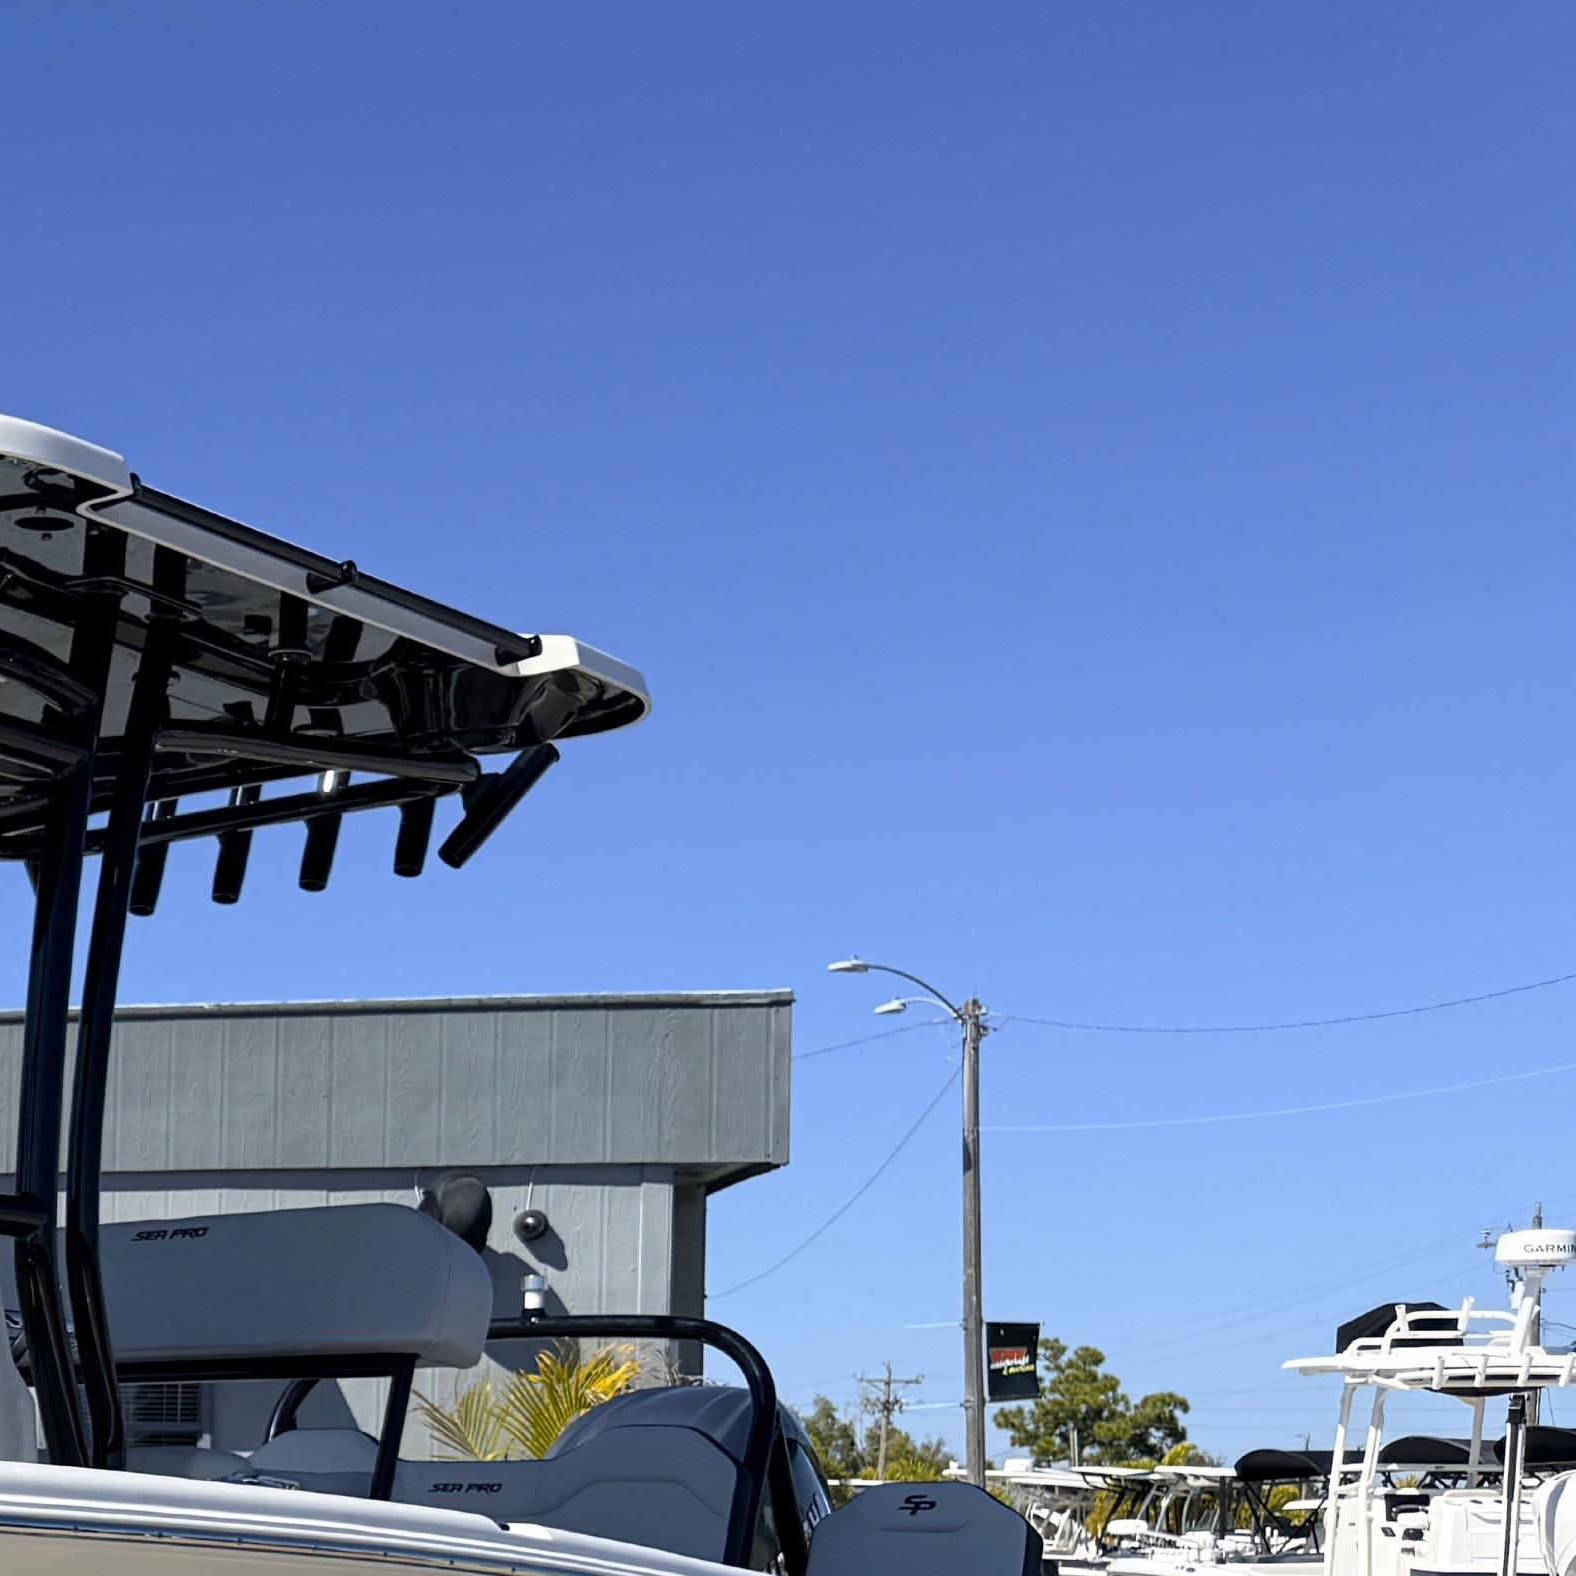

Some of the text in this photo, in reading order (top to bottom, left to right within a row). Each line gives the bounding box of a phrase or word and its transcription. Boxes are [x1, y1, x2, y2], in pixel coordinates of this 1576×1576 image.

[130, 1227, 208, 1241] SEA PRO
[428, 1482, 503, 1495] SEA PRO
